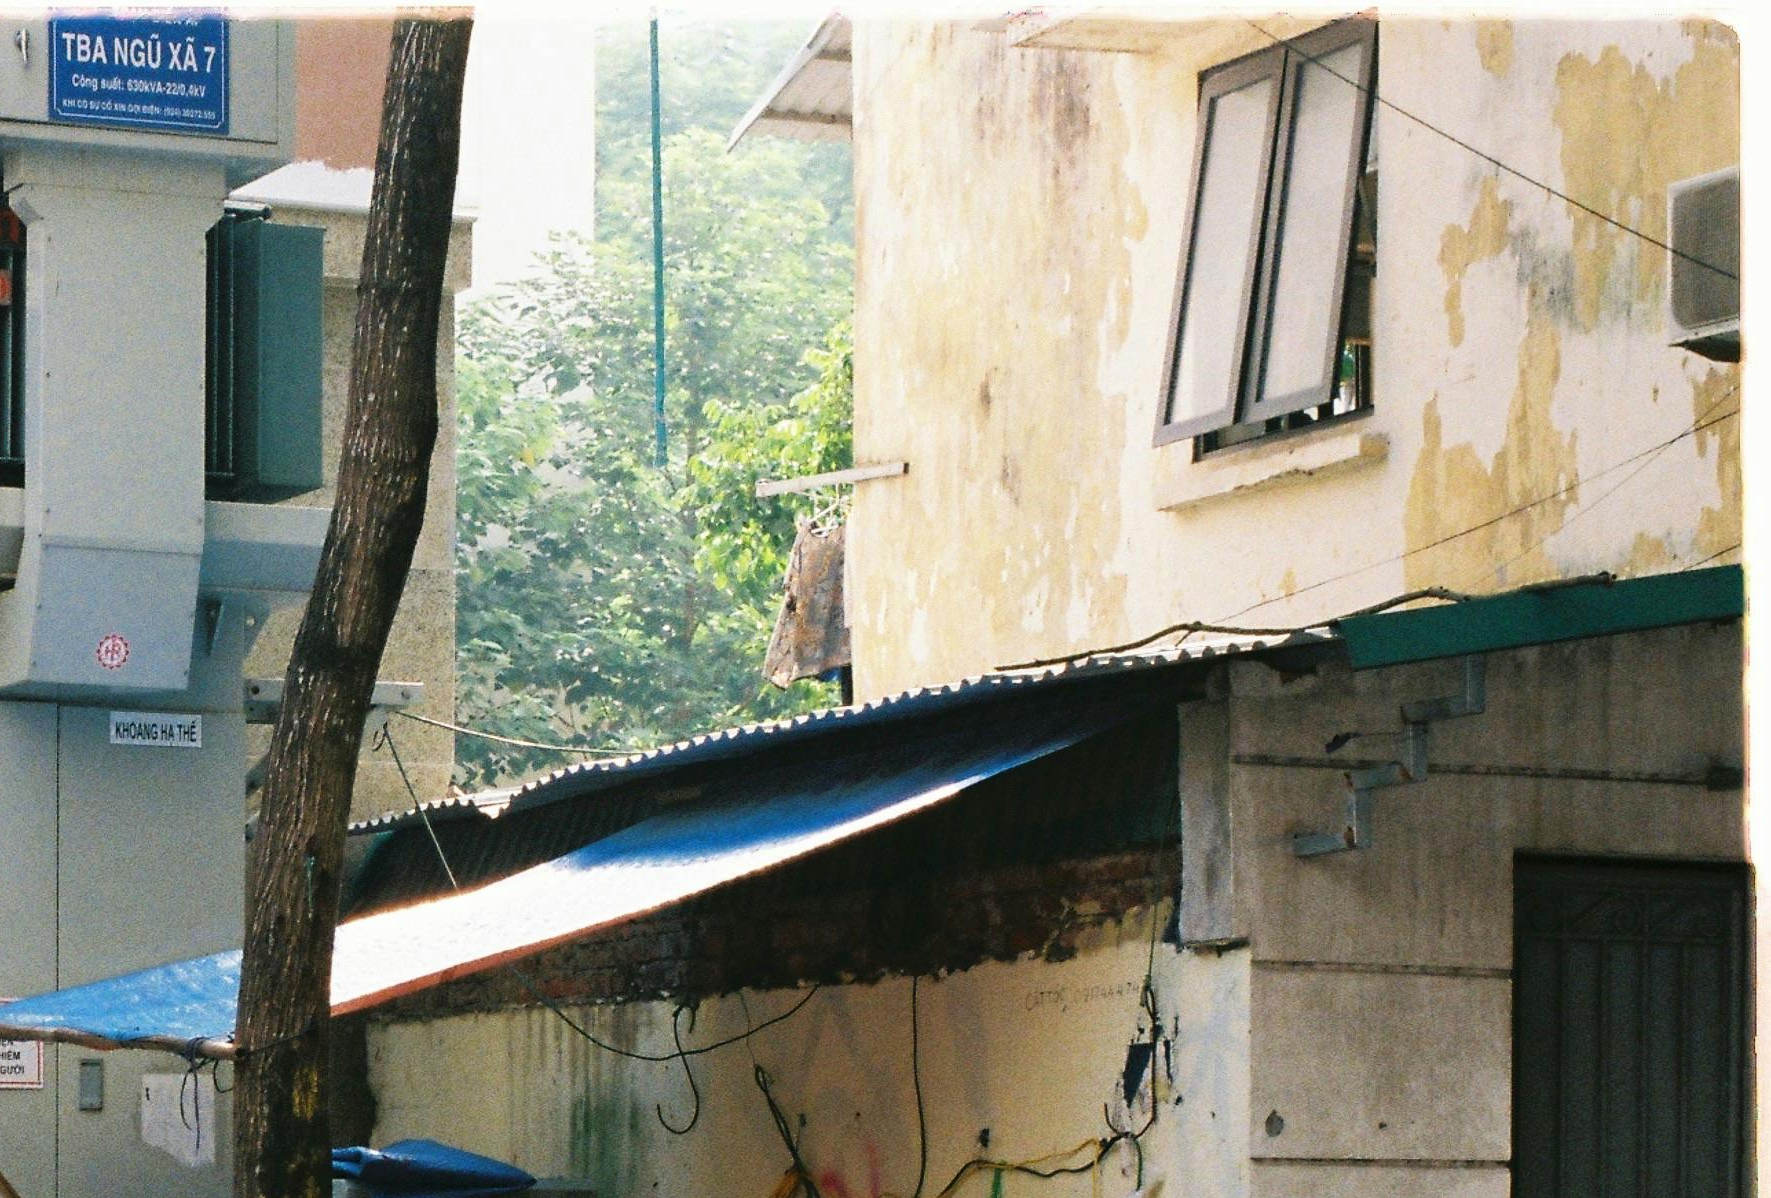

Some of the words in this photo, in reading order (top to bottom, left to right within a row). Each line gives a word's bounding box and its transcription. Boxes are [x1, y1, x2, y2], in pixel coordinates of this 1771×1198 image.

[62, 32, 107, 64] TBA
[114, 33, 161, 69] NGŨ
[168, 36, 198, 73] XÃ
[203, 46, 216, 73] 7
[72, 73, 98, 92] Công
[115, 721, 158, 740] KHOANG
